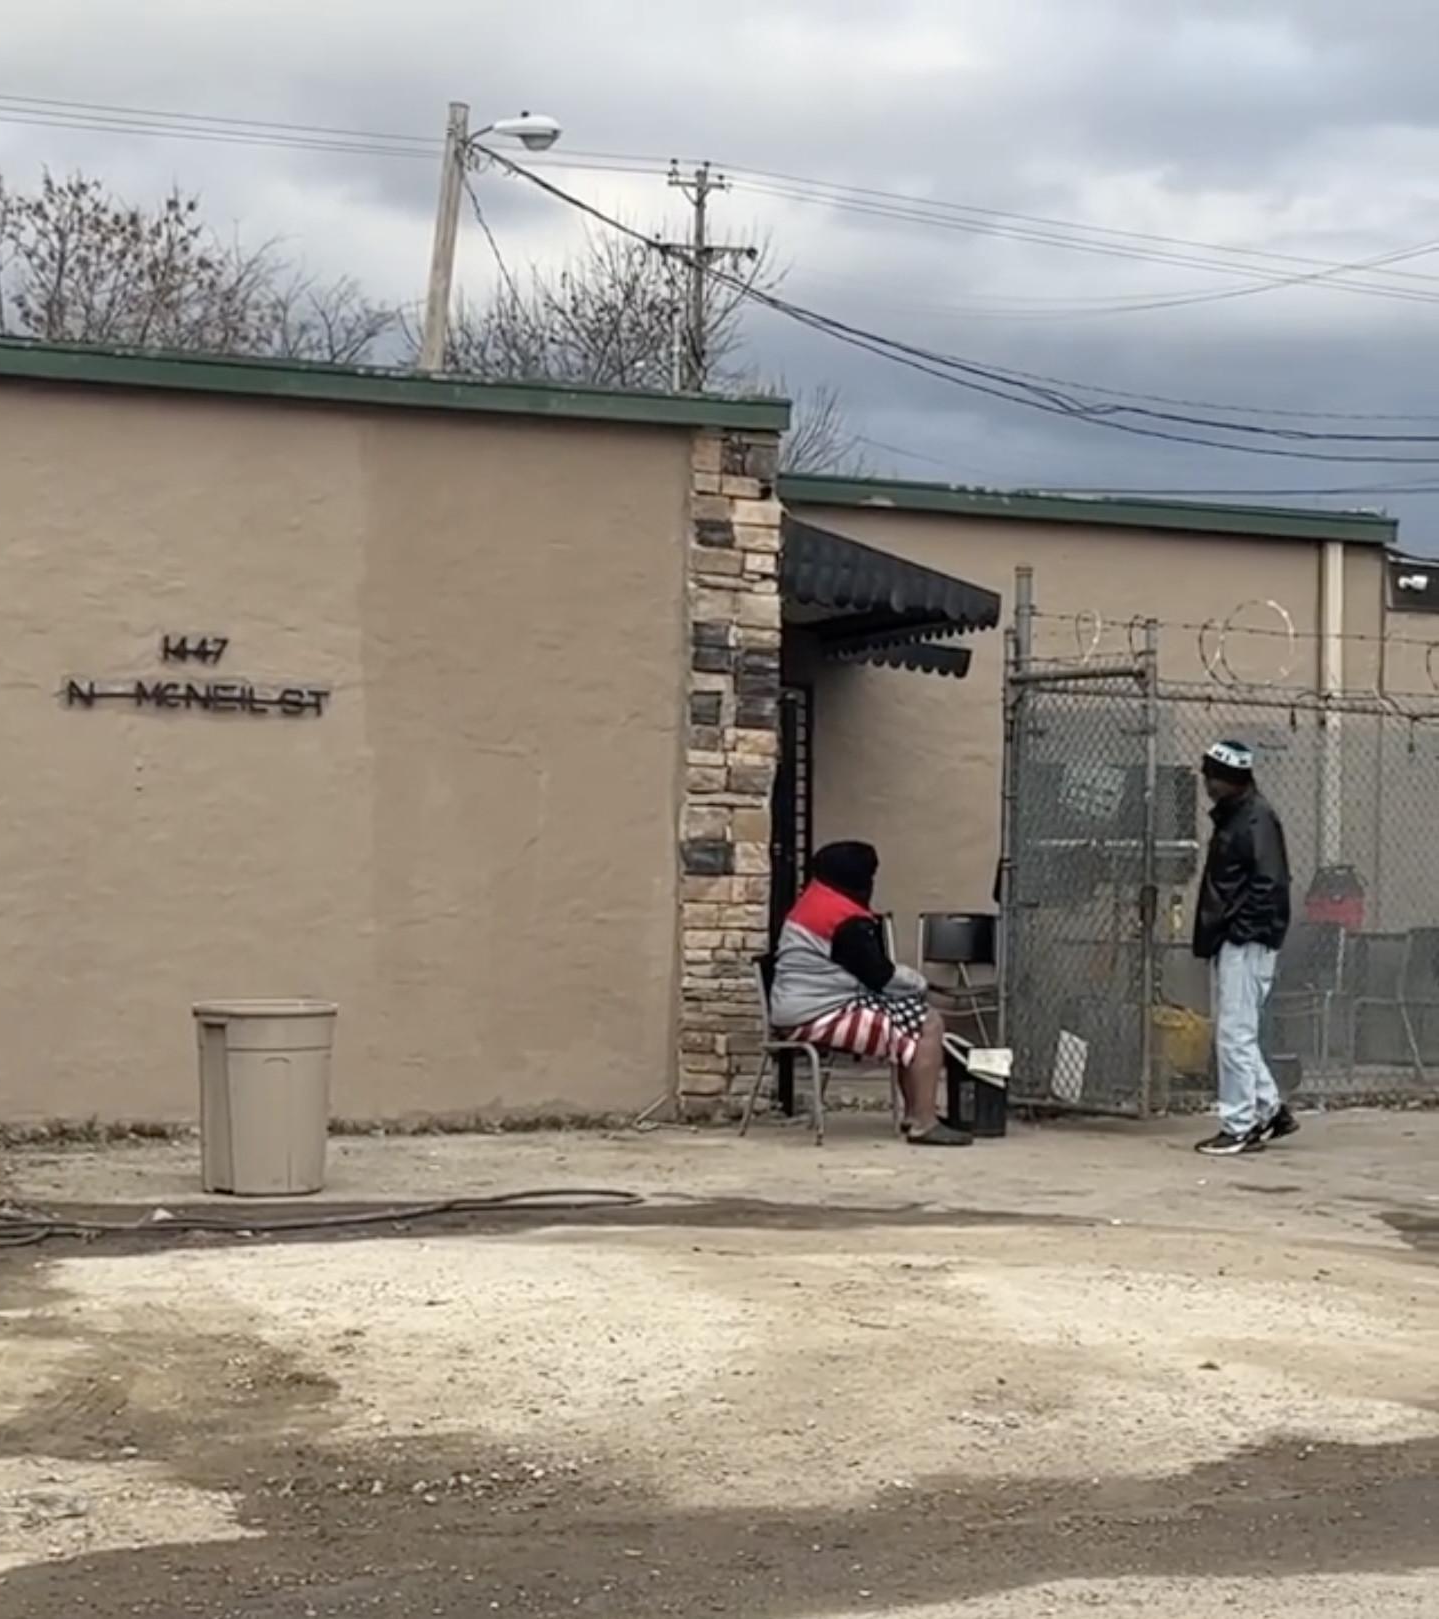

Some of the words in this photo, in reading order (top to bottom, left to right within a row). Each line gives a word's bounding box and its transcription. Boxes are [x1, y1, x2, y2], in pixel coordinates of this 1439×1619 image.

[161, 634, 230, 664] 1447
[66, 679, 96, 709] N
[279, 687, 331, 717] ST
